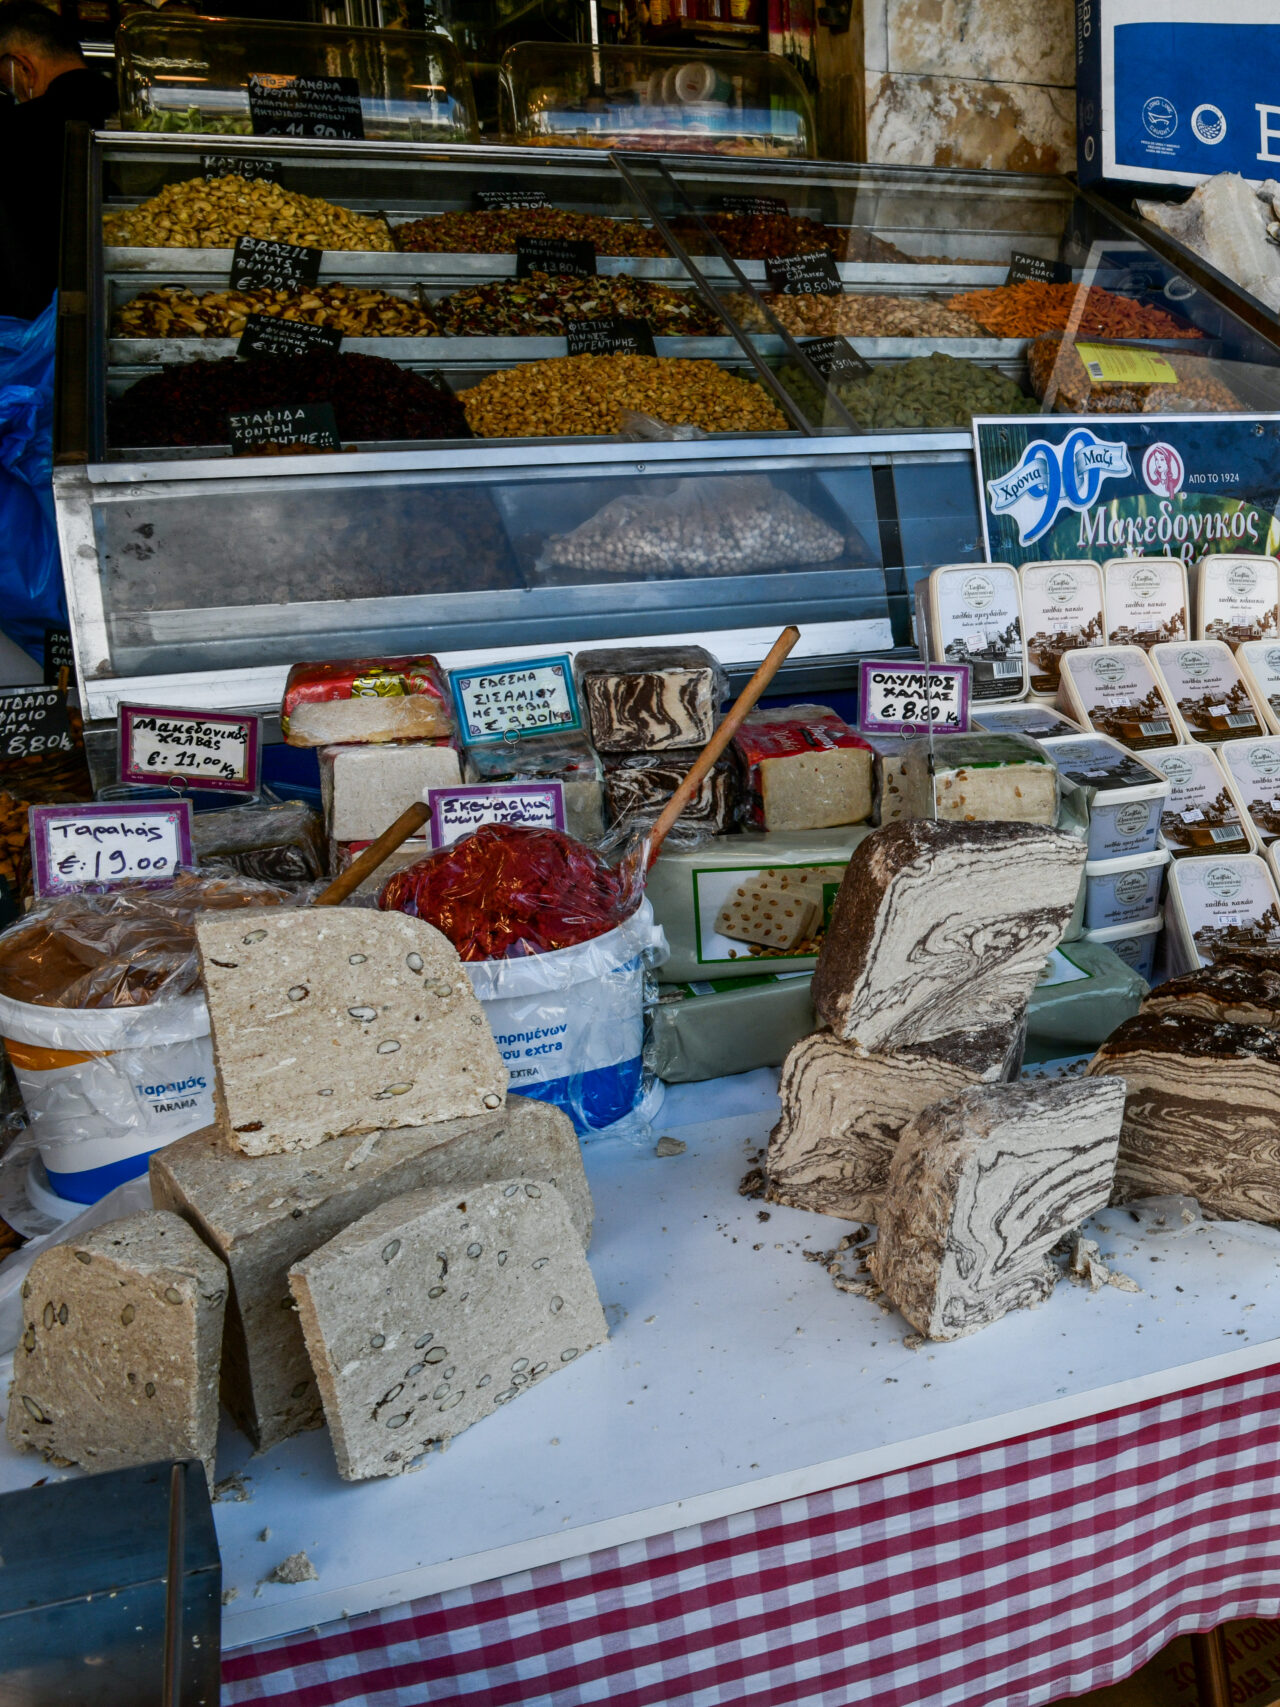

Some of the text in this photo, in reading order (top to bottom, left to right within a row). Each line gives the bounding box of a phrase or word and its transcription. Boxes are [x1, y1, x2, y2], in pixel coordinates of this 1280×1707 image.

[240, 236, 310, 260] BRAZIL
[250, 252, 293, 268] NUTS
[229, 408, 306, 427] ΣΤΑΦΙΔΑ
[235, 423, 293, 439] ΧΟΝΤΡΗ
[1084, 450, 1113, 468] Μαζί
[1000, 467, 1042, 501] Χρόνια
[1189, 472, 1240, 484] ΑΠΟ ΤΟ 1924
[1077, 500, 1259, 548] Μακεδονικός
[479, 672, 537, 689] ΕΔΕΣΜΑ
[872, 673, 955, 690] ΟΛΥΜΠΟΣ
[473, 687, 556, 705] ΣΙΣΑΜΙΟΥ
[473, 700, 551, 718] ΜΕ ΣΤΕΒΙΑ
[133, 718, 248, 745] Μακεδονικός
[147, 751, 168, 767] €:
[57, 854, 87, 875] €:
[525, 1041, 563, 1057] extra
[510, 1067, 539, 1079] EXTRA
[136, 1075, 207, 1097] Ταραμάς
[153, 1098, 198, 1114] TARAMA
